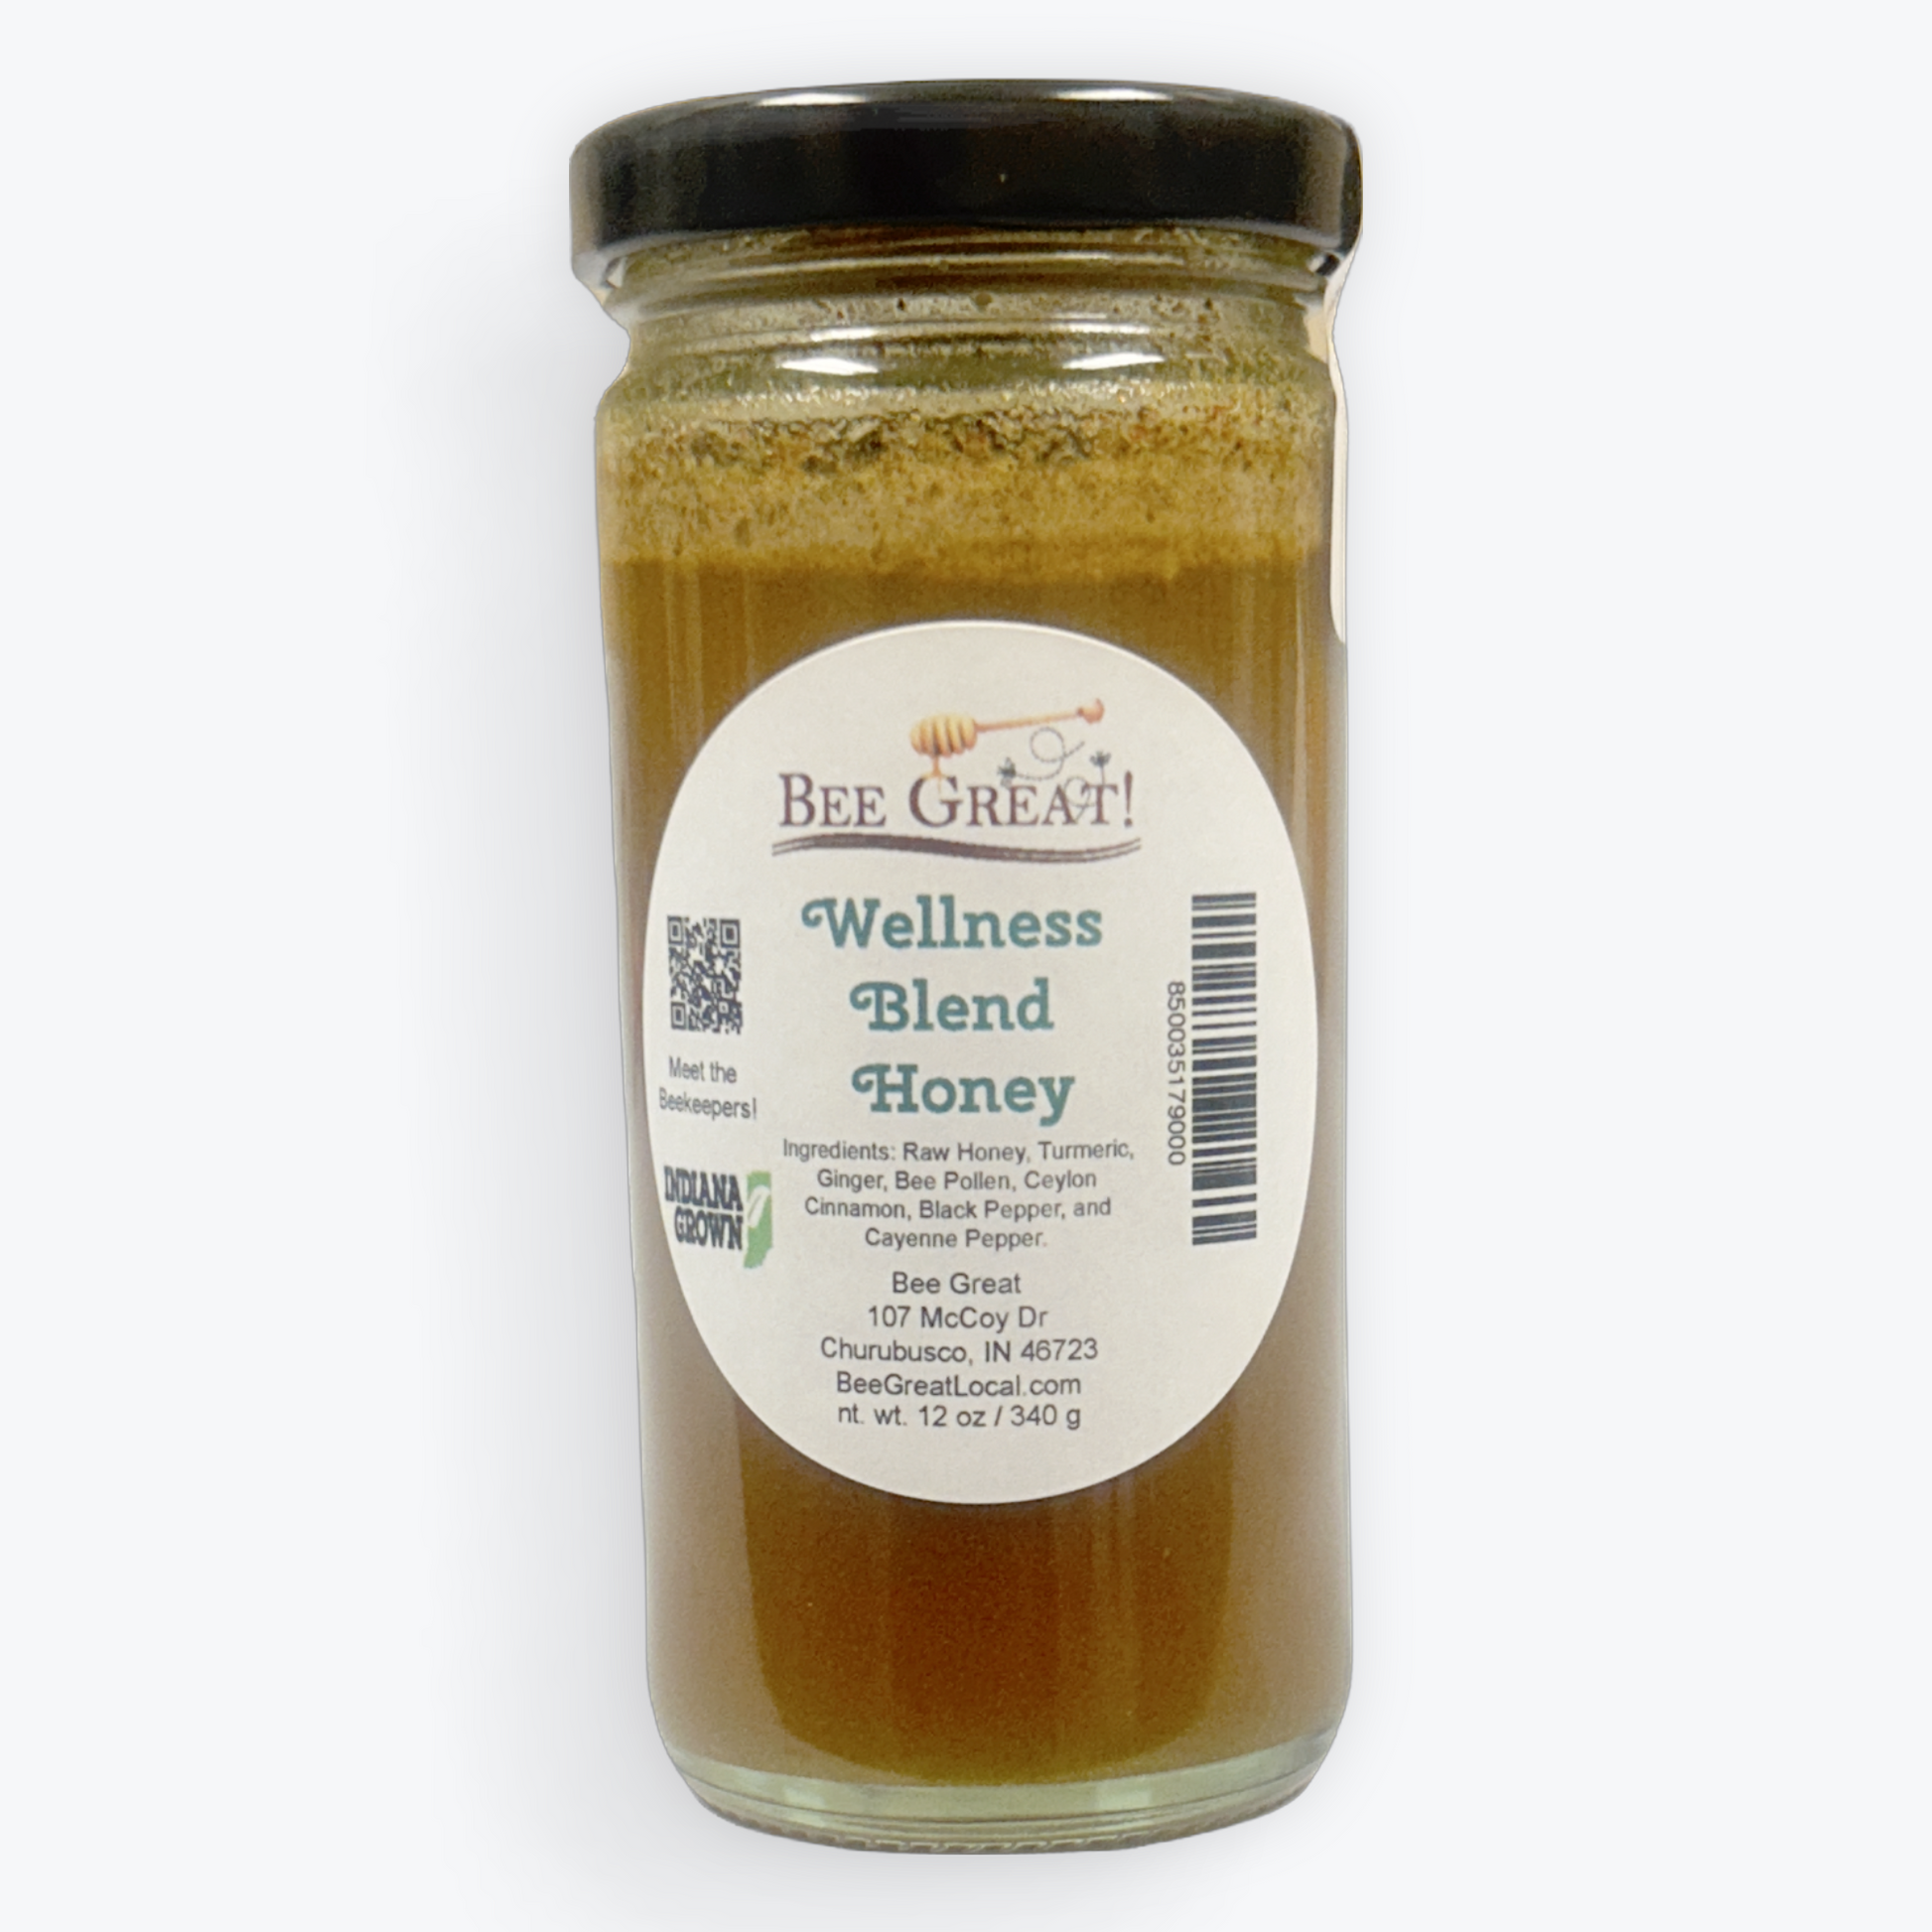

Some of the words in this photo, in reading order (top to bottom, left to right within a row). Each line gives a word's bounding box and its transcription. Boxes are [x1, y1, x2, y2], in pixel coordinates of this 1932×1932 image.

[778, 772, 887, 828] BEE
[800, 894, 1103, 950] Wellness
[849, 976, 1055, 1033] Blend
[668, 1055, 706, 1082] Meet
[709, 1060, 738, 1084] the
[1167, 980, 1186, 1167] 850035179000
[658, 1086, 758, 1122] Beekeepers!
[851, 1062, 1076, 1126] Honey
[783, 1138, 897, 1164] Ingredients:
[902, 1141, 950, 1162] Raw
[957, 1142, 1031, 1166] Honey,
[1036, 1139, 1135, 1162] Turmeric,
[663, 1166, 744, 1211] INDIANA
[816, 1168, 889, 1194] Ginger,
[895, 1170, 936, 1190] Bee
[943, 1170, 1017, 1192] Pollen,
[1023, 1169, 1097, 1194] Ceylon
[804, 1195, 912, 1222] Cinnamon,
[918, 1199, 978, 1220] Black
[984, 1198, 1066, 1223] Pepper,
[1072, 1196, 1112, 1217] and
[673, 1205, 745, 1251] GROWN
[865, 1226, 958, 1252] Cayenne
[965, 1227, 1047, 1252] Pepper.
[892, 1270, 941, 1295] Bee
[949, 1272, 1022, 1296] Great
[868, 1305, 911, 1328] 107
[920, 1306, 1010, 1334] McCoy
[1018, 1305, 1048, 1328] Dr
[820, 1335, 974, 1366] Churubusco,
[985, 1339, 1012, 1363] IN
[1020, 1336, 1099, 1362] 46723
[836, 1370, 1081, 1398] BeeGreatLocal.com
[838, 1403, 864, 1425] nt.
[873, 1405, 907, 1427] wt.
[918, 1404, 947, 1428] 12
[956, 1410, 987, 1428] oz
[993, 1405, 1004, 1428] /
[1010, 1403, 1058, 1428] 340
[1065, 1408, 1081, 1432] g
